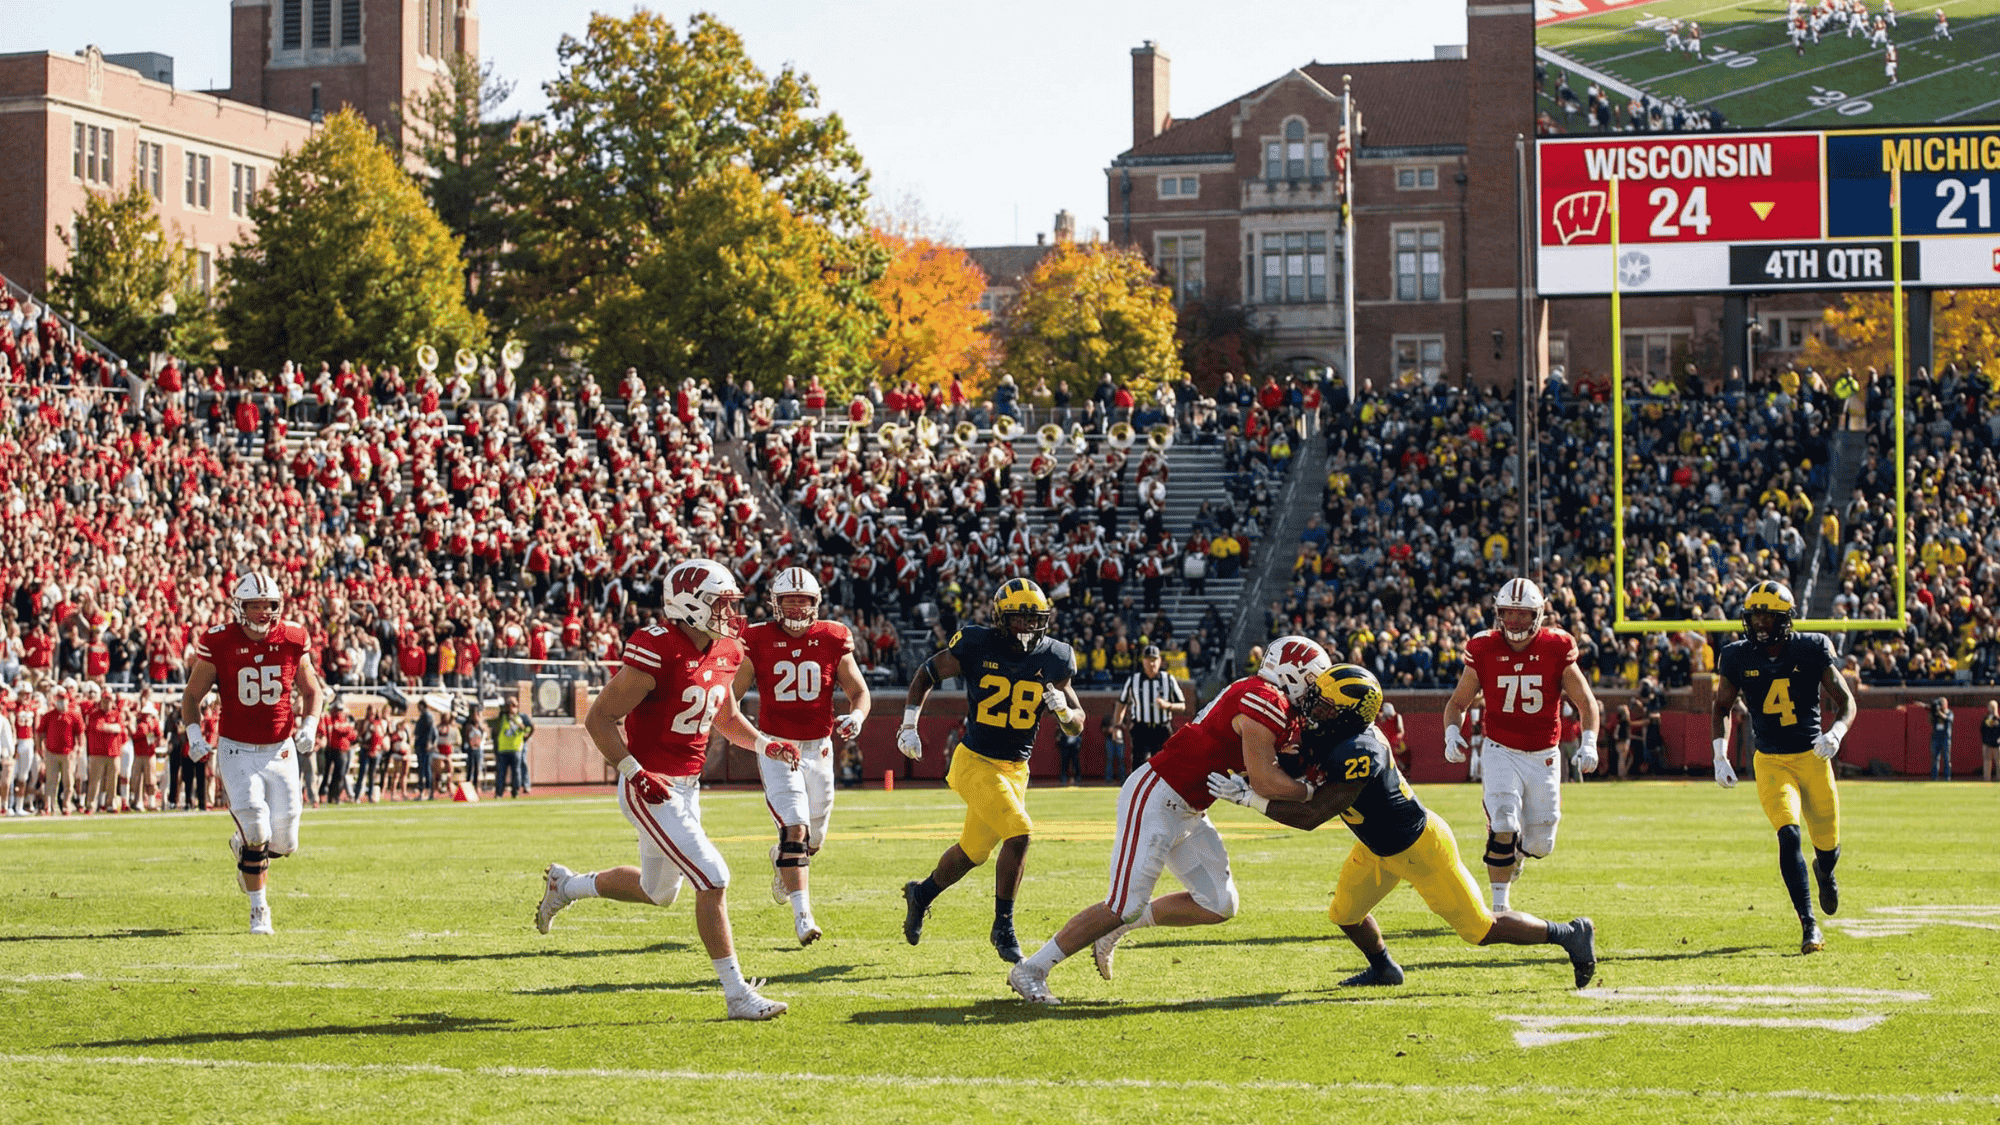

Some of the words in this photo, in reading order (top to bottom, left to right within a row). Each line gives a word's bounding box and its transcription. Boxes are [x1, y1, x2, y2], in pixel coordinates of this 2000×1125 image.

[1584, 143, 1772, 181] WISCONSIN
[1882, 136, 2000, 171] MICHIG
[1648, 186, 1711, 236] 24
[1935, 178, 1991, 229] 21
[1764, 249, 1819, 279] 4TH
[1827, 248, 1883, 280] QTR
[671, 567, 710, 598] W
[1279, 641, 1319, 668] W
[237, 666, 283, 707] 65
[773, 660, 821, 701] 20
[1497, 674, 1544, 714] 75
[976, 674, 1044, 730] 28
[1762, 678, 1797, 727] 4
[1344, 755, 1370, 780] 23
